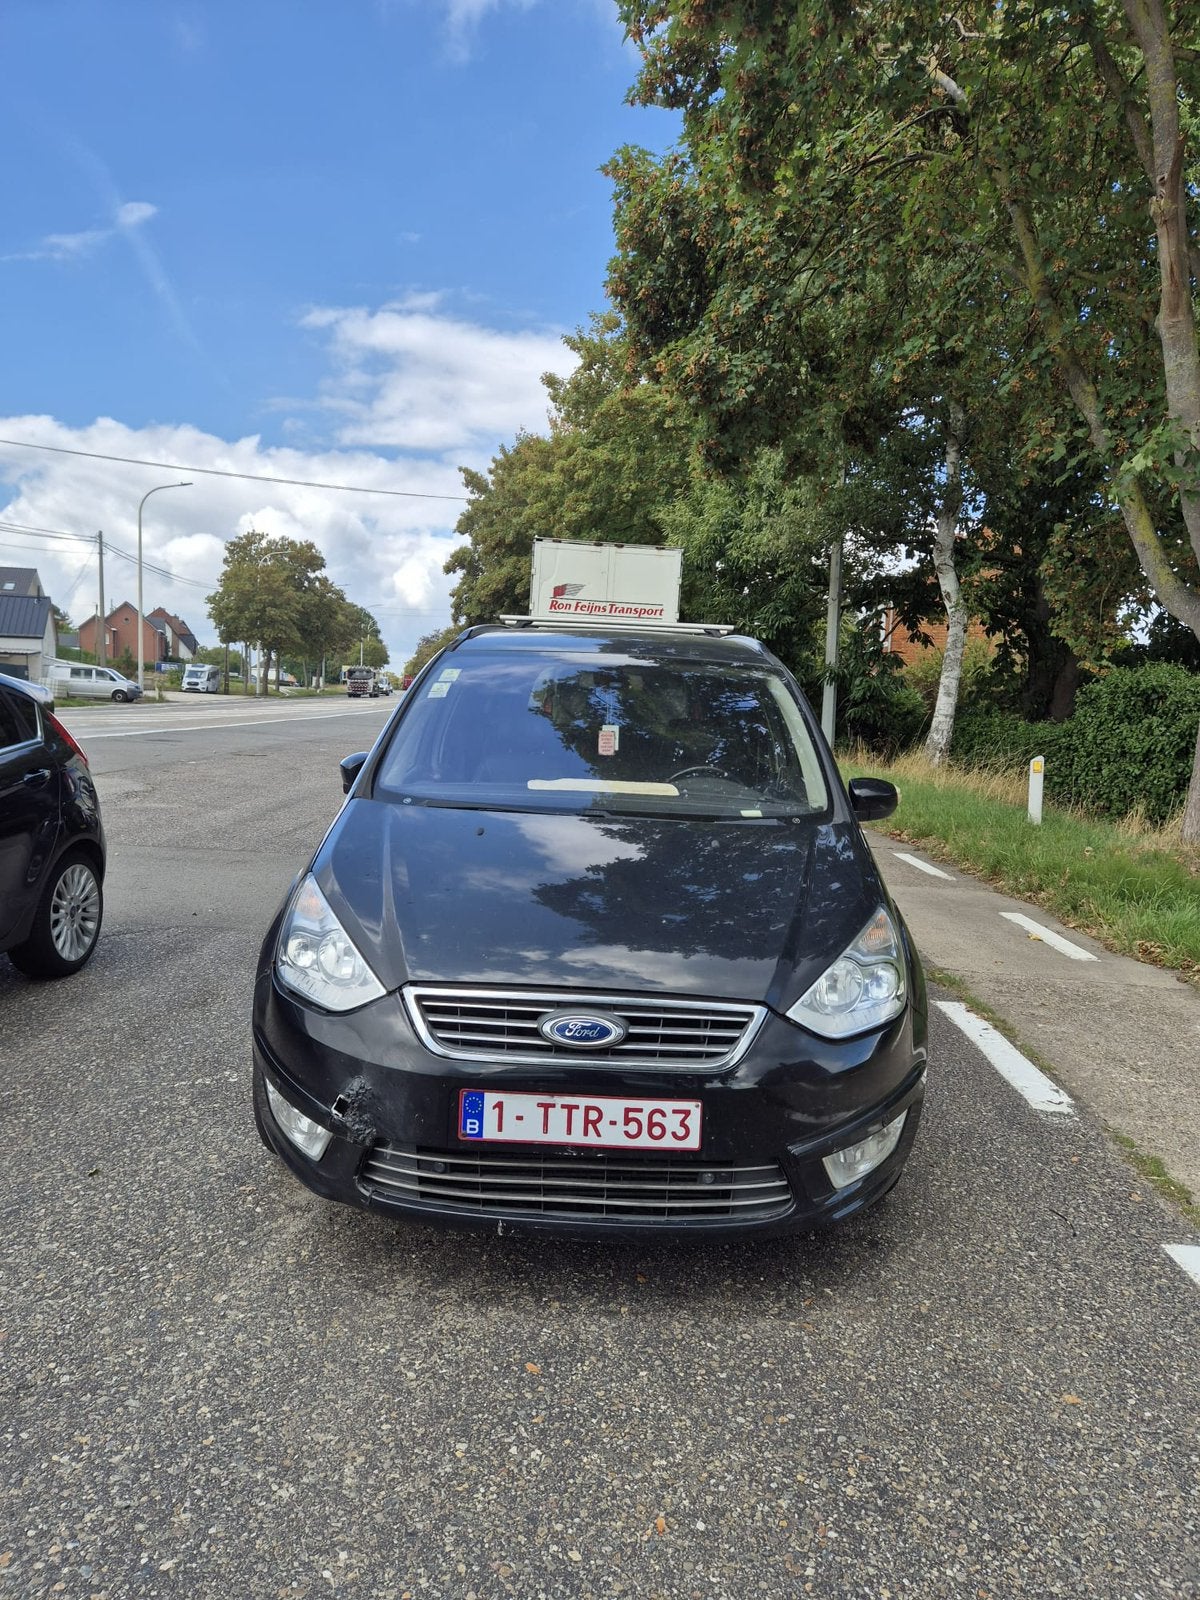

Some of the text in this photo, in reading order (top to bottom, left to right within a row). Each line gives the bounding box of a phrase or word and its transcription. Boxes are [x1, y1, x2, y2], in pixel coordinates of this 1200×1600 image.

[549, 599, 664, 618] Ron Feijns Transport
[565, 1021, 600, 1037] Ford
[466, 1119, 479, 1134] B
[492, 1100, 692, 1141] 1-TTR-563
